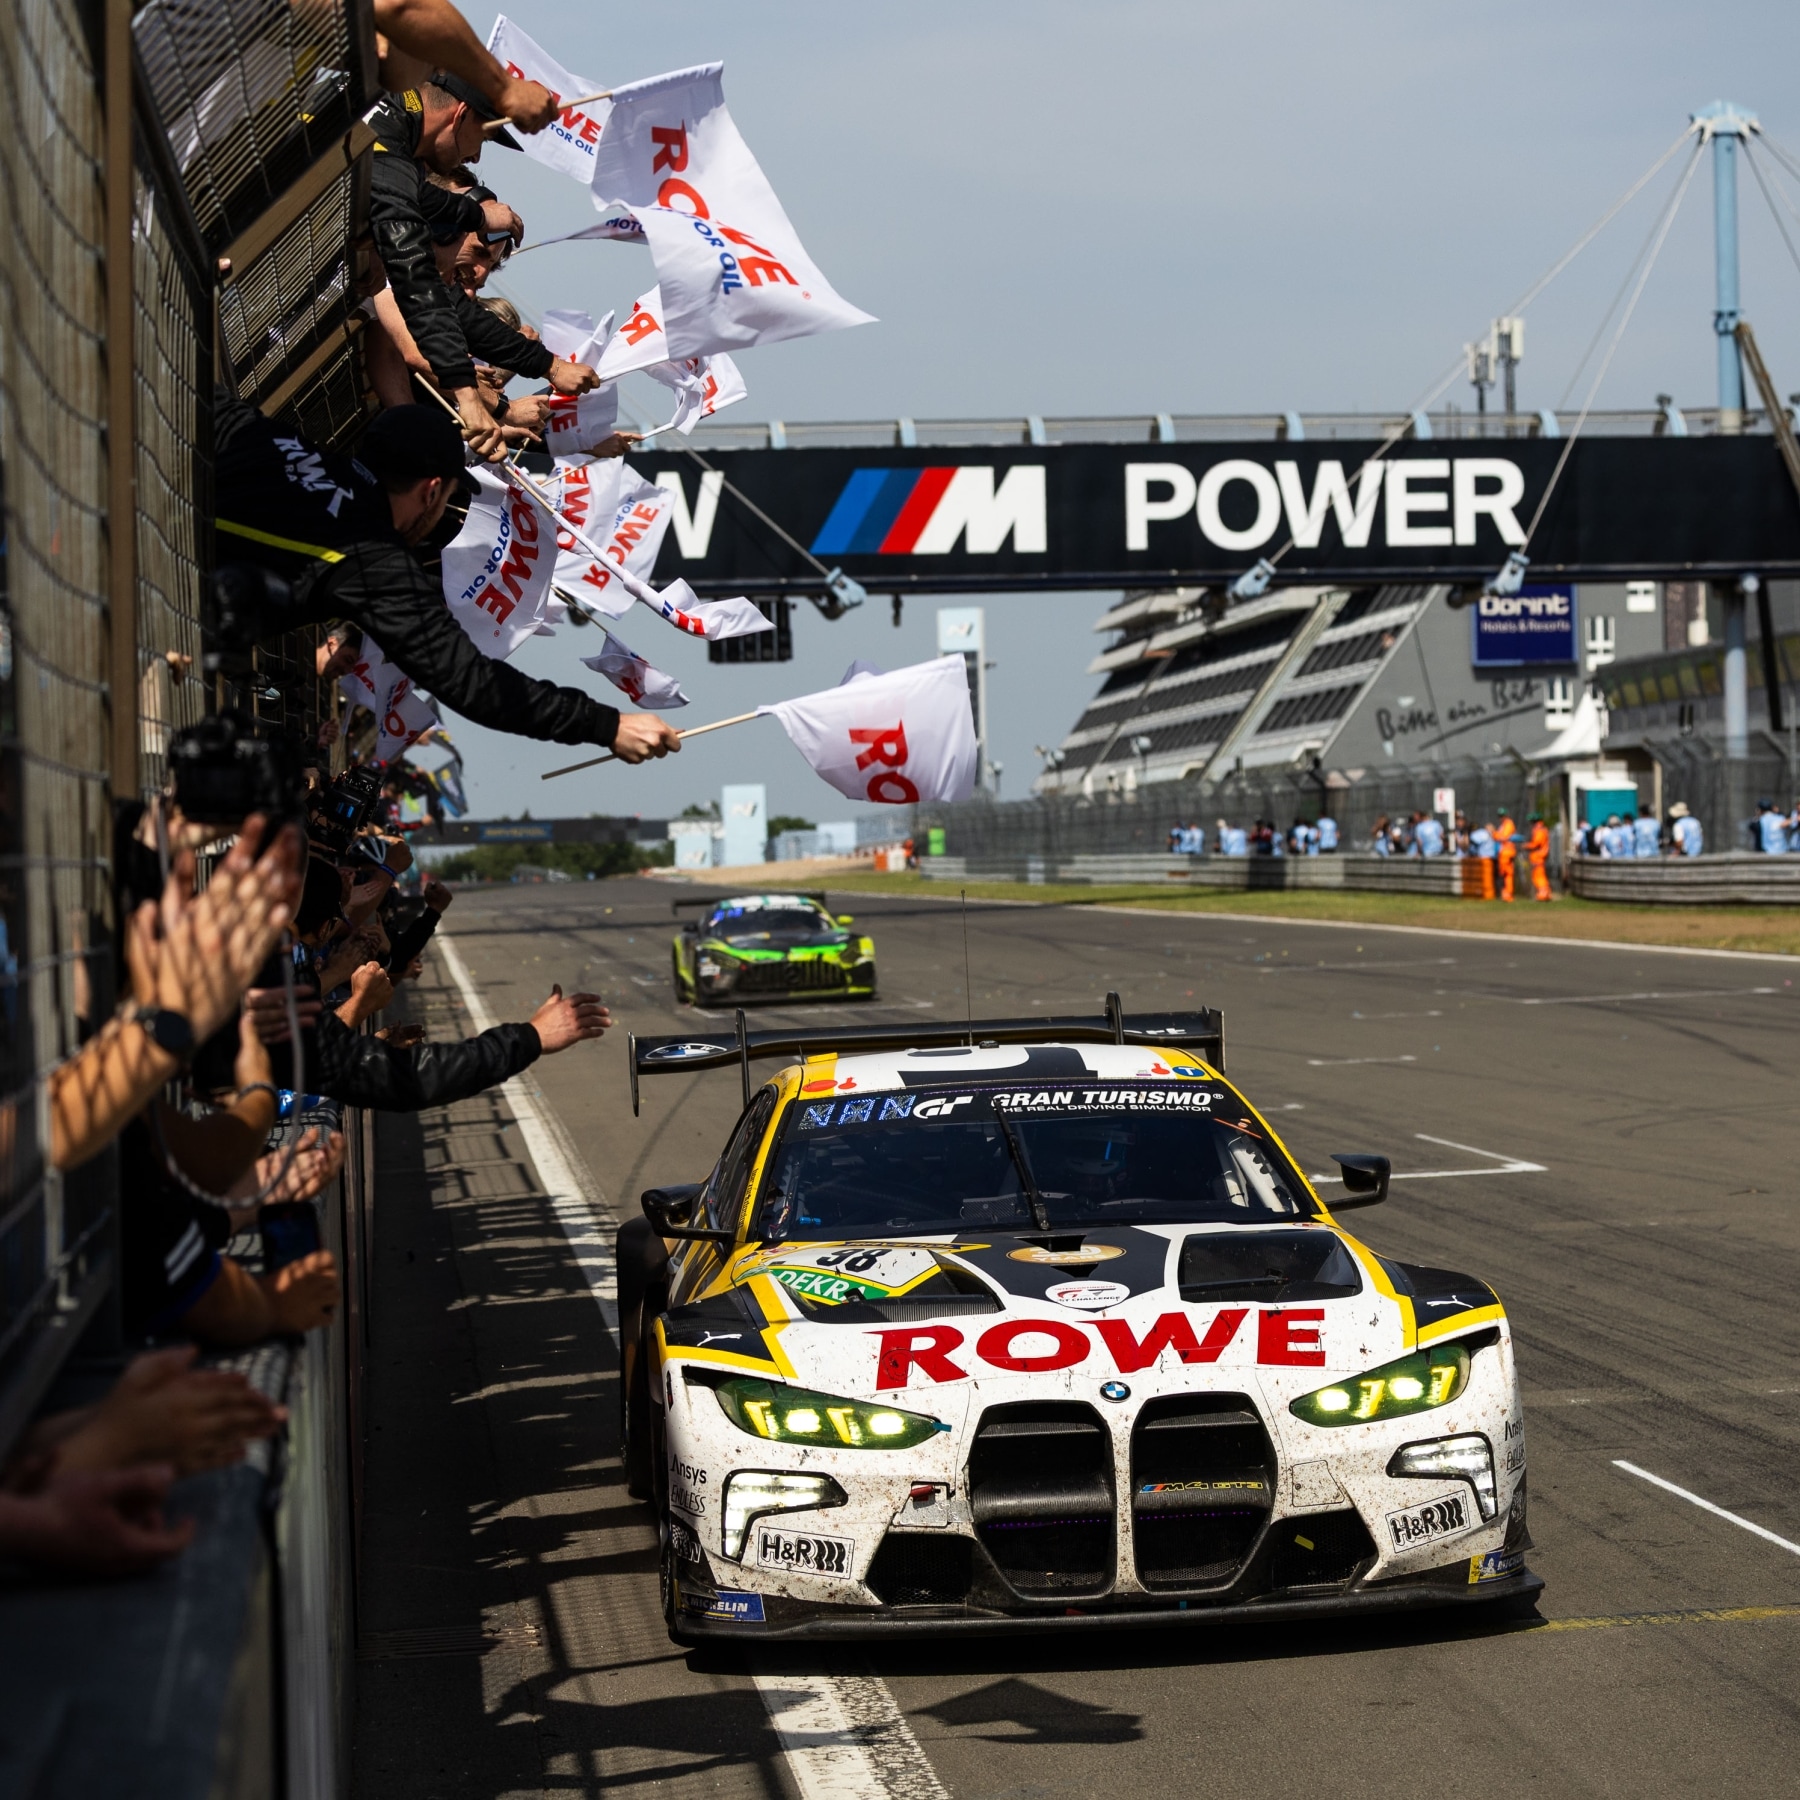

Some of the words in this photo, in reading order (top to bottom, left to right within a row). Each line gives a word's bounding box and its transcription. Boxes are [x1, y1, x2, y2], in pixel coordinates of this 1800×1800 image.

[548, 122, 573, 144] TOR
[575, 139, 594, 156] OIL
[1125, 458, 1528, 551] POWER
[483, 505, 511, 575] MOTOR
[461, 574, 487, 602] OIL
[990, 1091, 1079, 1107] GRAN
[1130, 1103, 1212, 1112] SIMULATOR
[862, 1308, 1326, 1391] ROWE
[670, 1453, 708, 1487] Ansys
[671, 1484, 707, 1514] ENDLESS
[1390, 1505, 1441, 1545] H&R
[760, 1532, 815, 1567] H&R
